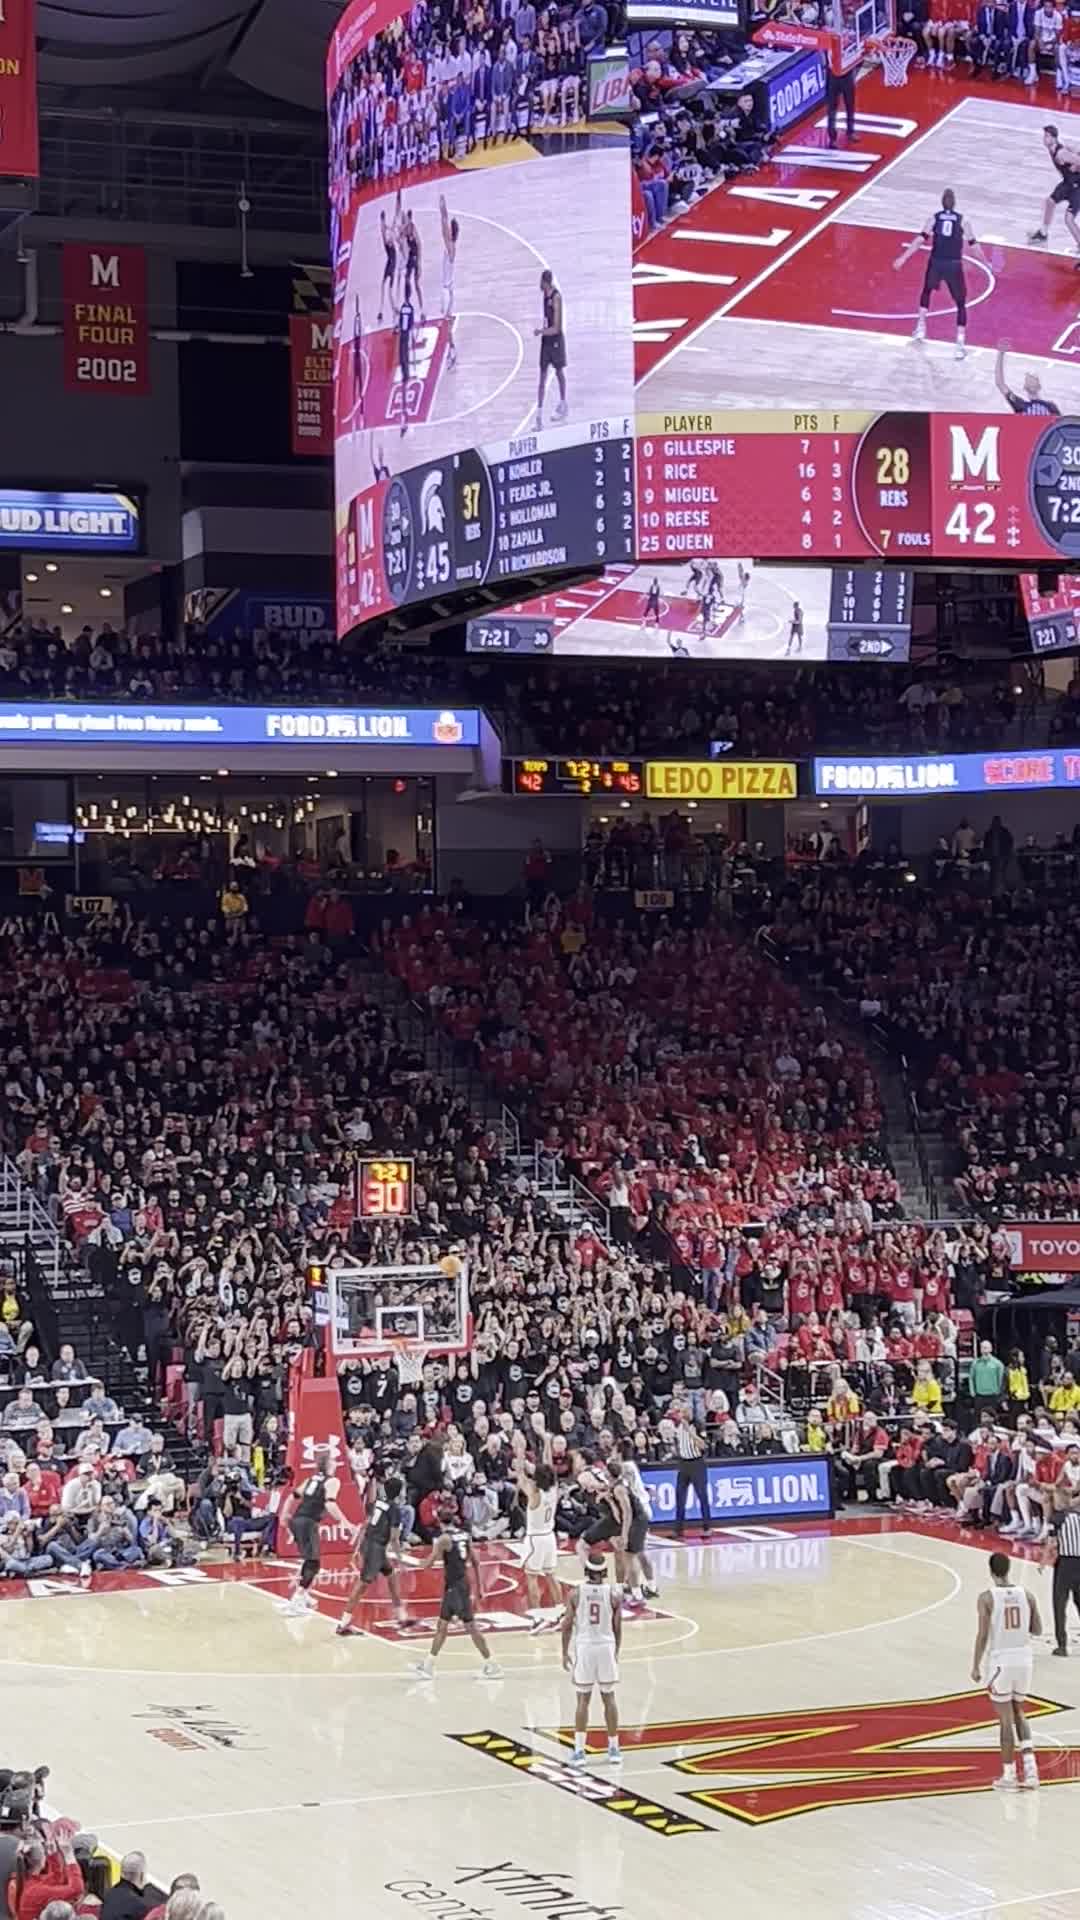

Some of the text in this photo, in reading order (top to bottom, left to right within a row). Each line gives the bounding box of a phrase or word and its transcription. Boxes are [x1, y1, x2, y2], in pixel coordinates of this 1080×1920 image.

[770, 80, 802, 124] FOOD
[91, 254, 120, 287] M
[75, 304, 136, 324] FINAL
[79, 326, 134, 345] FOUR
[77, 357, 136, 382] 2002
[304, 357, 333, 368] ELIT
[664, 414, 841, 431] PLAYER PTS F
[509, 420, 630, 458] PLAYER PTS F
[643, 439, 840, 457] 0 GILLESPIE 7 1
[595, 447, 603, 463] 3
[622, 444, 631, 459] 2
[949, 425, 1000, 482] M
[645, 463, 842, 480] 1 RICE 16 3
[876, 448, 910, 484] 28
[596, 471, 604, 486] 2
[624, 468, 630, 483] 1
[463, 482, 480, 520] 37
[644, 487, 842, 504] 9 MIGUEL 6 3
[880, 490, 908, 507] REBS
[499, 512, 506, 529] 5
[596, 493, 605, 509] 6
[623, 491, 632, 506] 3
[642, 510, 842, 527] 10 REESE 4 2
[0, 509, 41, 532] UD
[945, 502, 997, 544] 42
[511, 528, 544, 549] ZAPALA
[596, 517, 605, 533] 6
[623, 515, 632, 531] 2
[880, 529, 931, 548] 7 FOULS
[641, 533, 841, 551] 25 QUEEN 8 1
[427, 541, 450, 584] 45
[499, 557, 509, 574] 11
[597, 541, 605, 556] 9
[624, 538, 631, 553] 1
[475, 560, 482, 579] 6
[847, 570, 854, 583] 1
[874, 570, 882, 583] 2
[845, 583, 905, 597] 5 6 3
[843, 596, 905, 610] 10 6 2
[264, 605, 325, 628] BUD
[842, 609, 854, 622] 11
[871, 610, 881, 623] 9
[479, 629, 549, 647] 7:21 30
[1035, 627, 1055, 645] 7:21
[859, 640, 881, 654] 2ND
[266, 715, 325, 738] FOOD
[520, 773, 543, 792] 42
[581, 780, 591, 792] 2
[618, 774, 640, 792] 45
[649, 767, 794, 794] LEDO PIZZA
[821, 764, 875, 789] FOOD
[365, 1181, 404, 1213] 30
[1028, 1239, 1080, 1256] TOYO
[588, 1602, 600, 1625] 9
[1004, 1605, 1021, 1630] 10
[454, 1862, 625, 1920] xfinit
